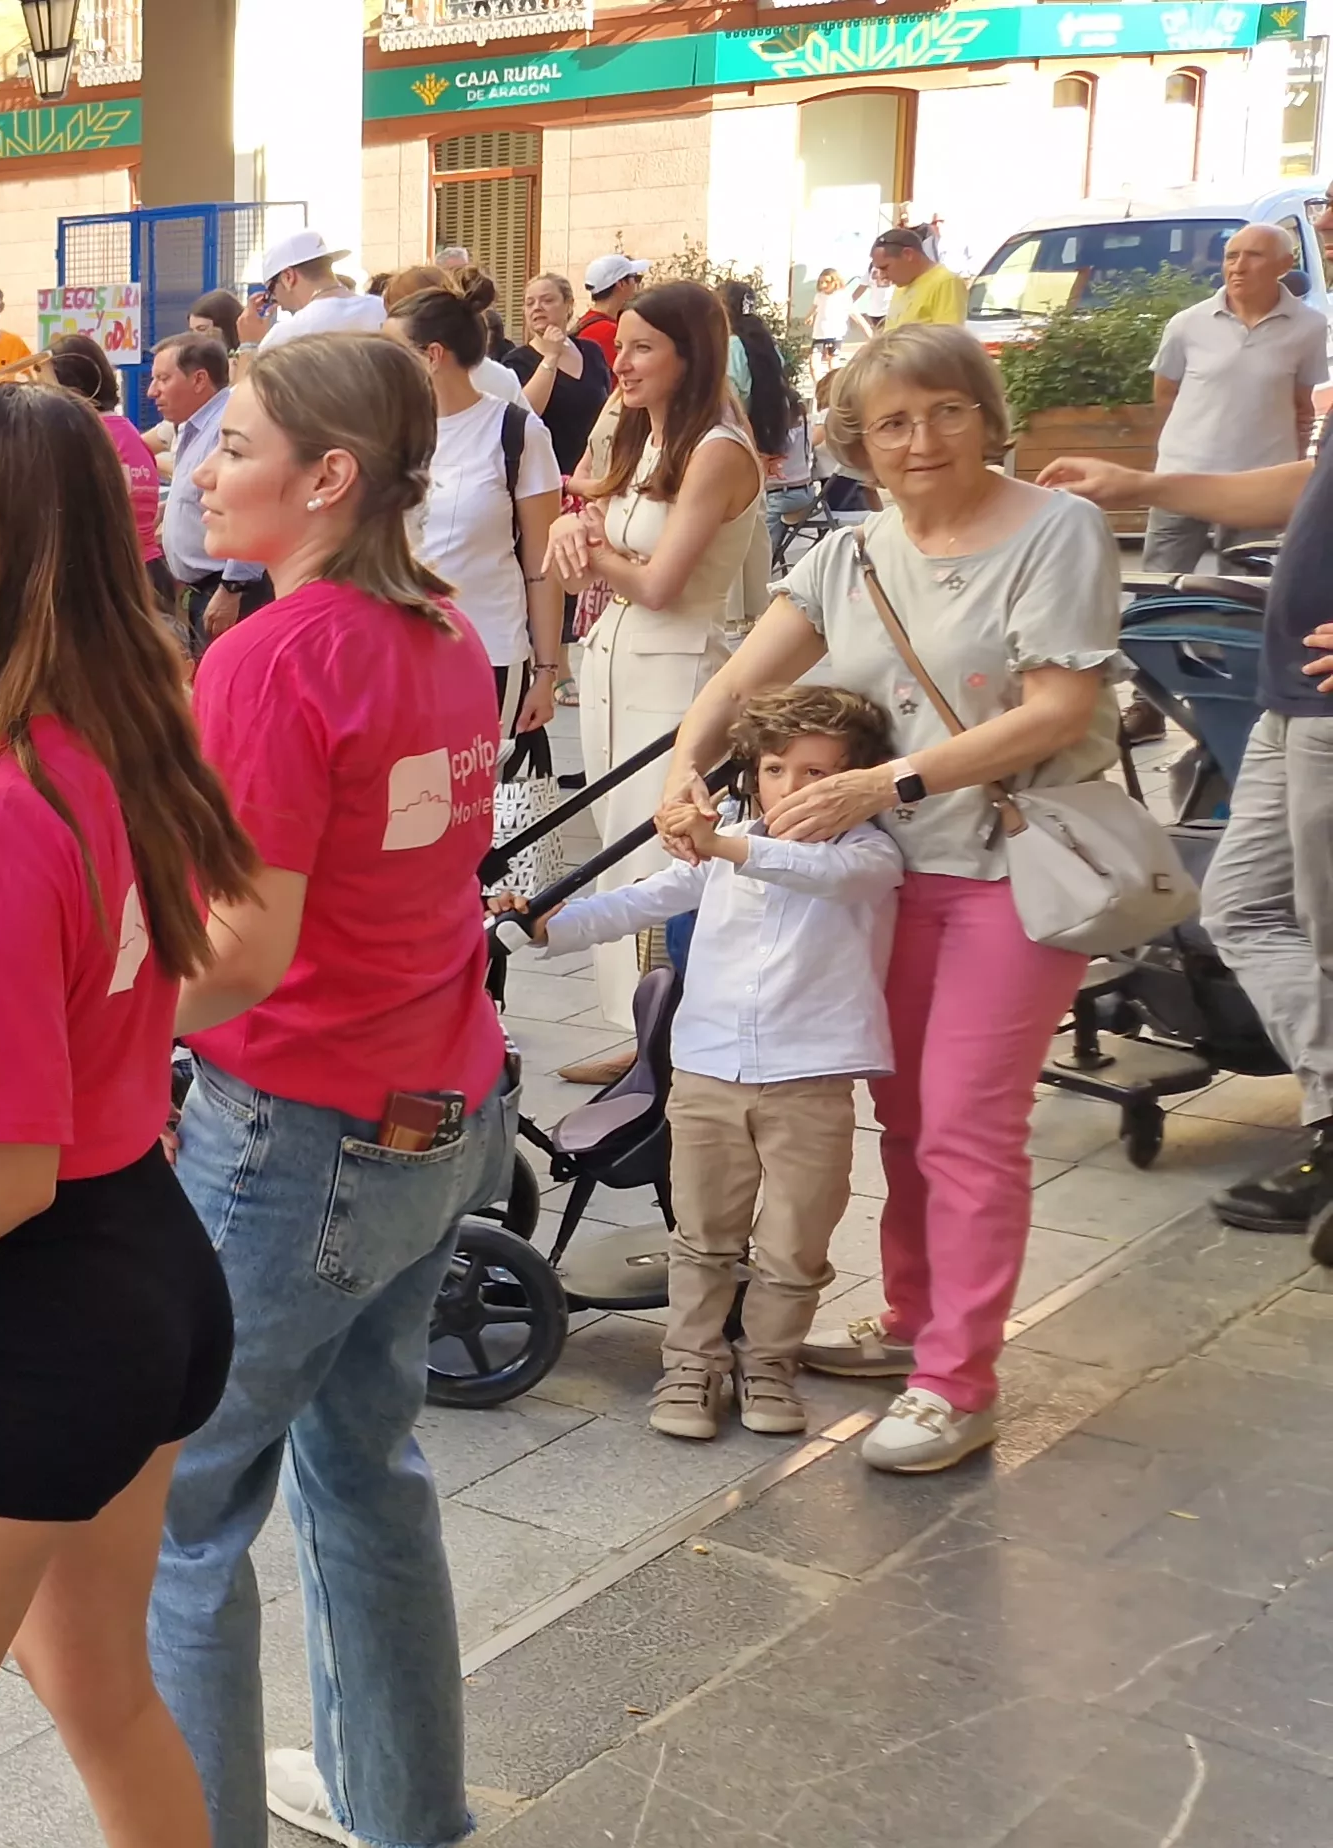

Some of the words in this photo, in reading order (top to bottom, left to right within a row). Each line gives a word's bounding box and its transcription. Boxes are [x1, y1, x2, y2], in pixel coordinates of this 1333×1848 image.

[455, 69, 500, 88] CAJA
[503, 63, 563, 83] RURAL
[466, 89, 486, 102] DE
[38, 286, 107, 311] JUEGOS
